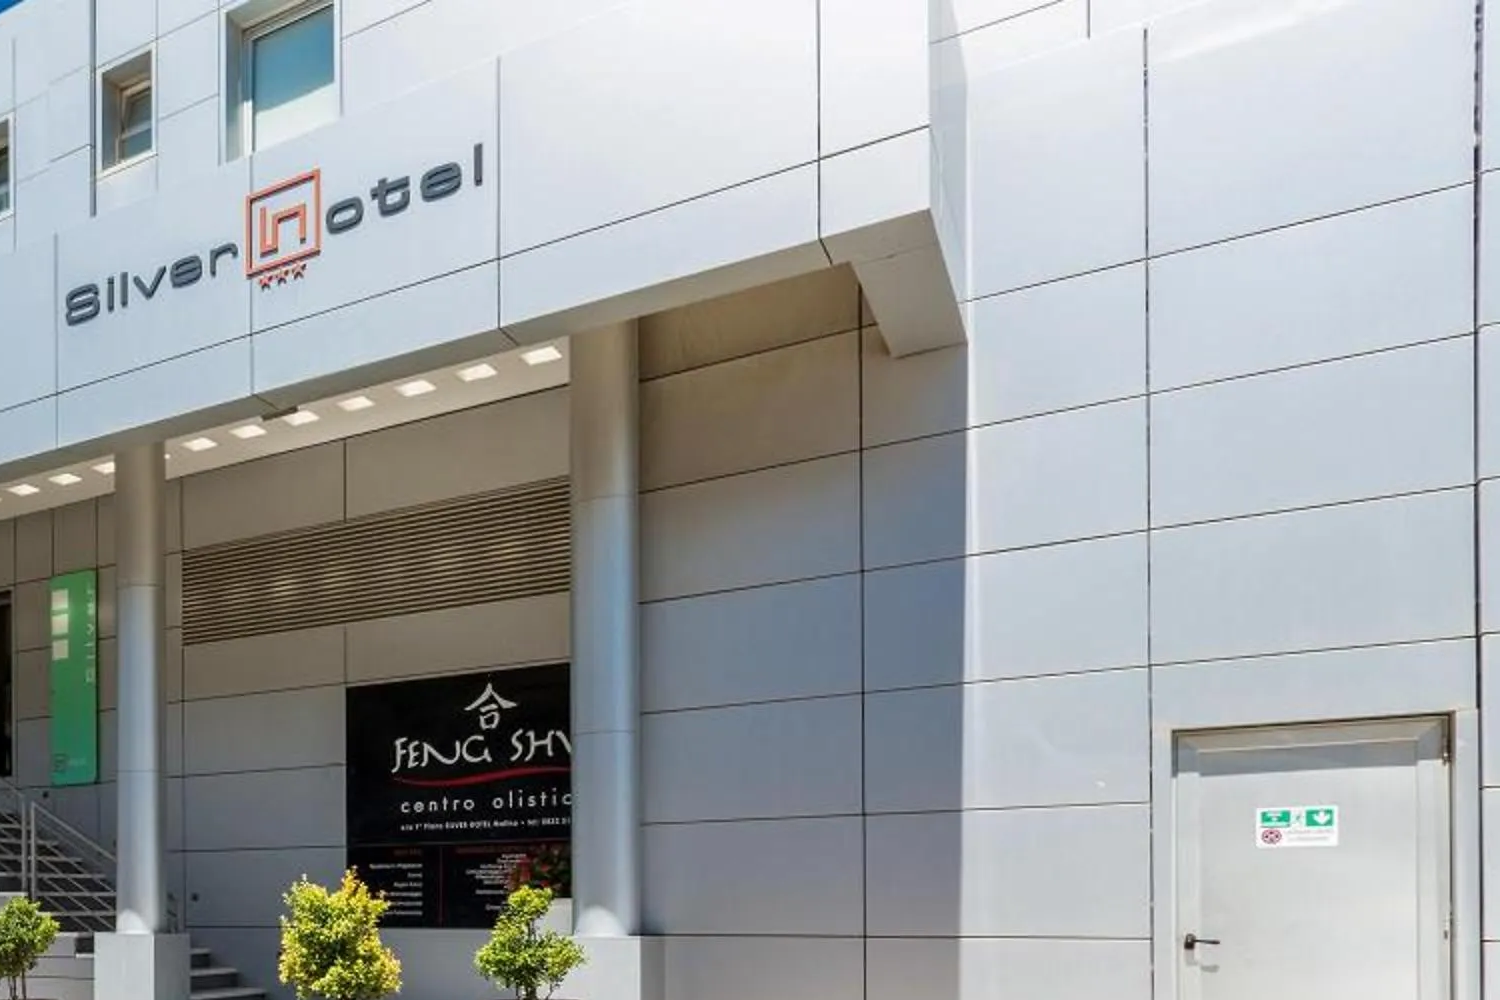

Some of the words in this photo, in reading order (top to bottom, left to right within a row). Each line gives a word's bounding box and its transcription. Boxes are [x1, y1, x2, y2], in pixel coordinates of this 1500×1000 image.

[64, 240, 240, 327] Silver
[391, 735, 493, 774] FENG
[510, 728, 572, 763] SH
[400, 796, 475, 814] centro
[492, 787, 572, 809] olistic
